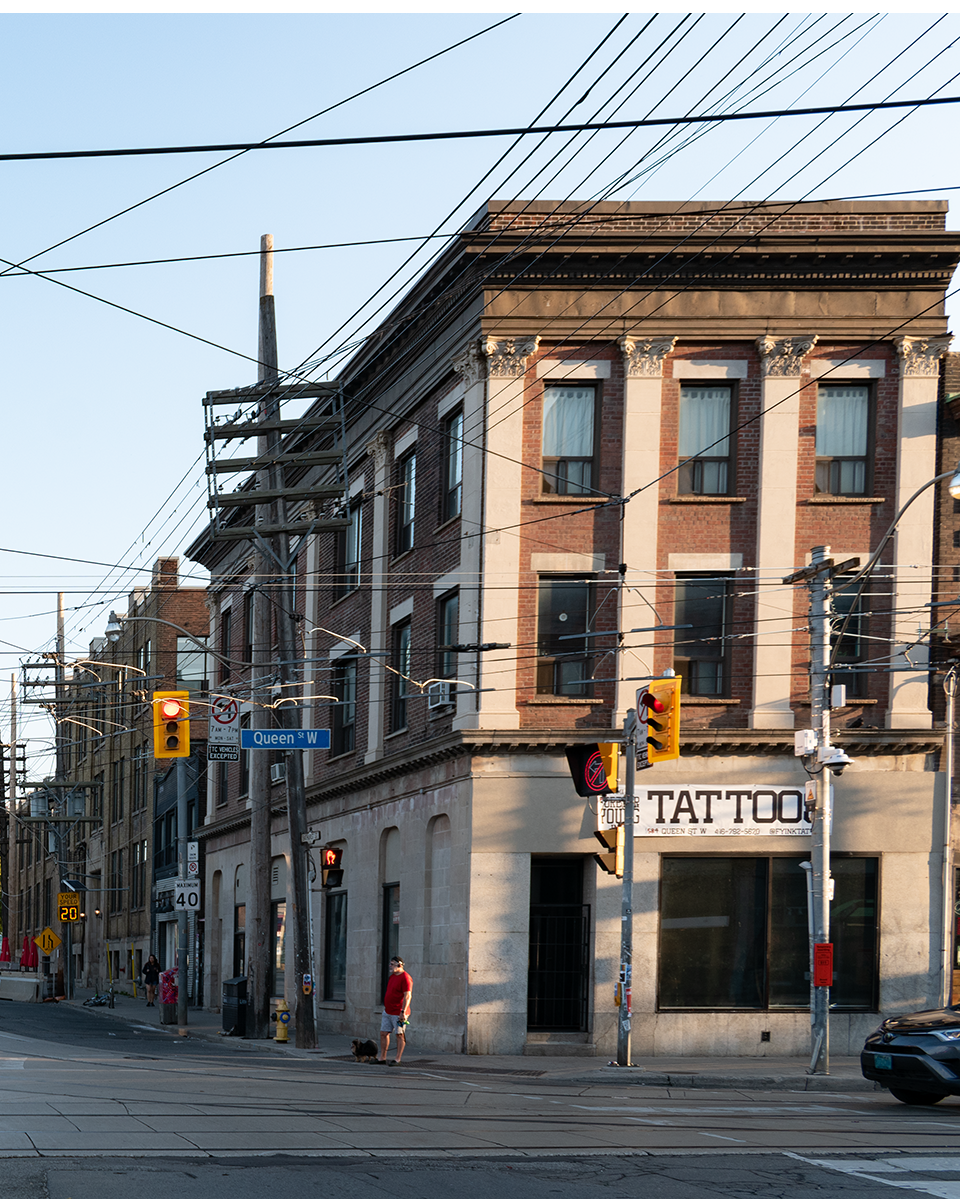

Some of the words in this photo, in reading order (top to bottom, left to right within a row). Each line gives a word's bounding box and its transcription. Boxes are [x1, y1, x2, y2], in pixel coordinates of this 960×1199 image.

[253, 731, 294, 745] Queen
[297, 731, 304, 739] St
[307, 731, 318, 744] W
[647, 790, 812, 824] TATTOO
[600, 808, 640, 824] YOUG
[661, 827, 686, 835] QUEEN
[176, 892, 198, 907] 40
[60, 907, 77, 920] 20
